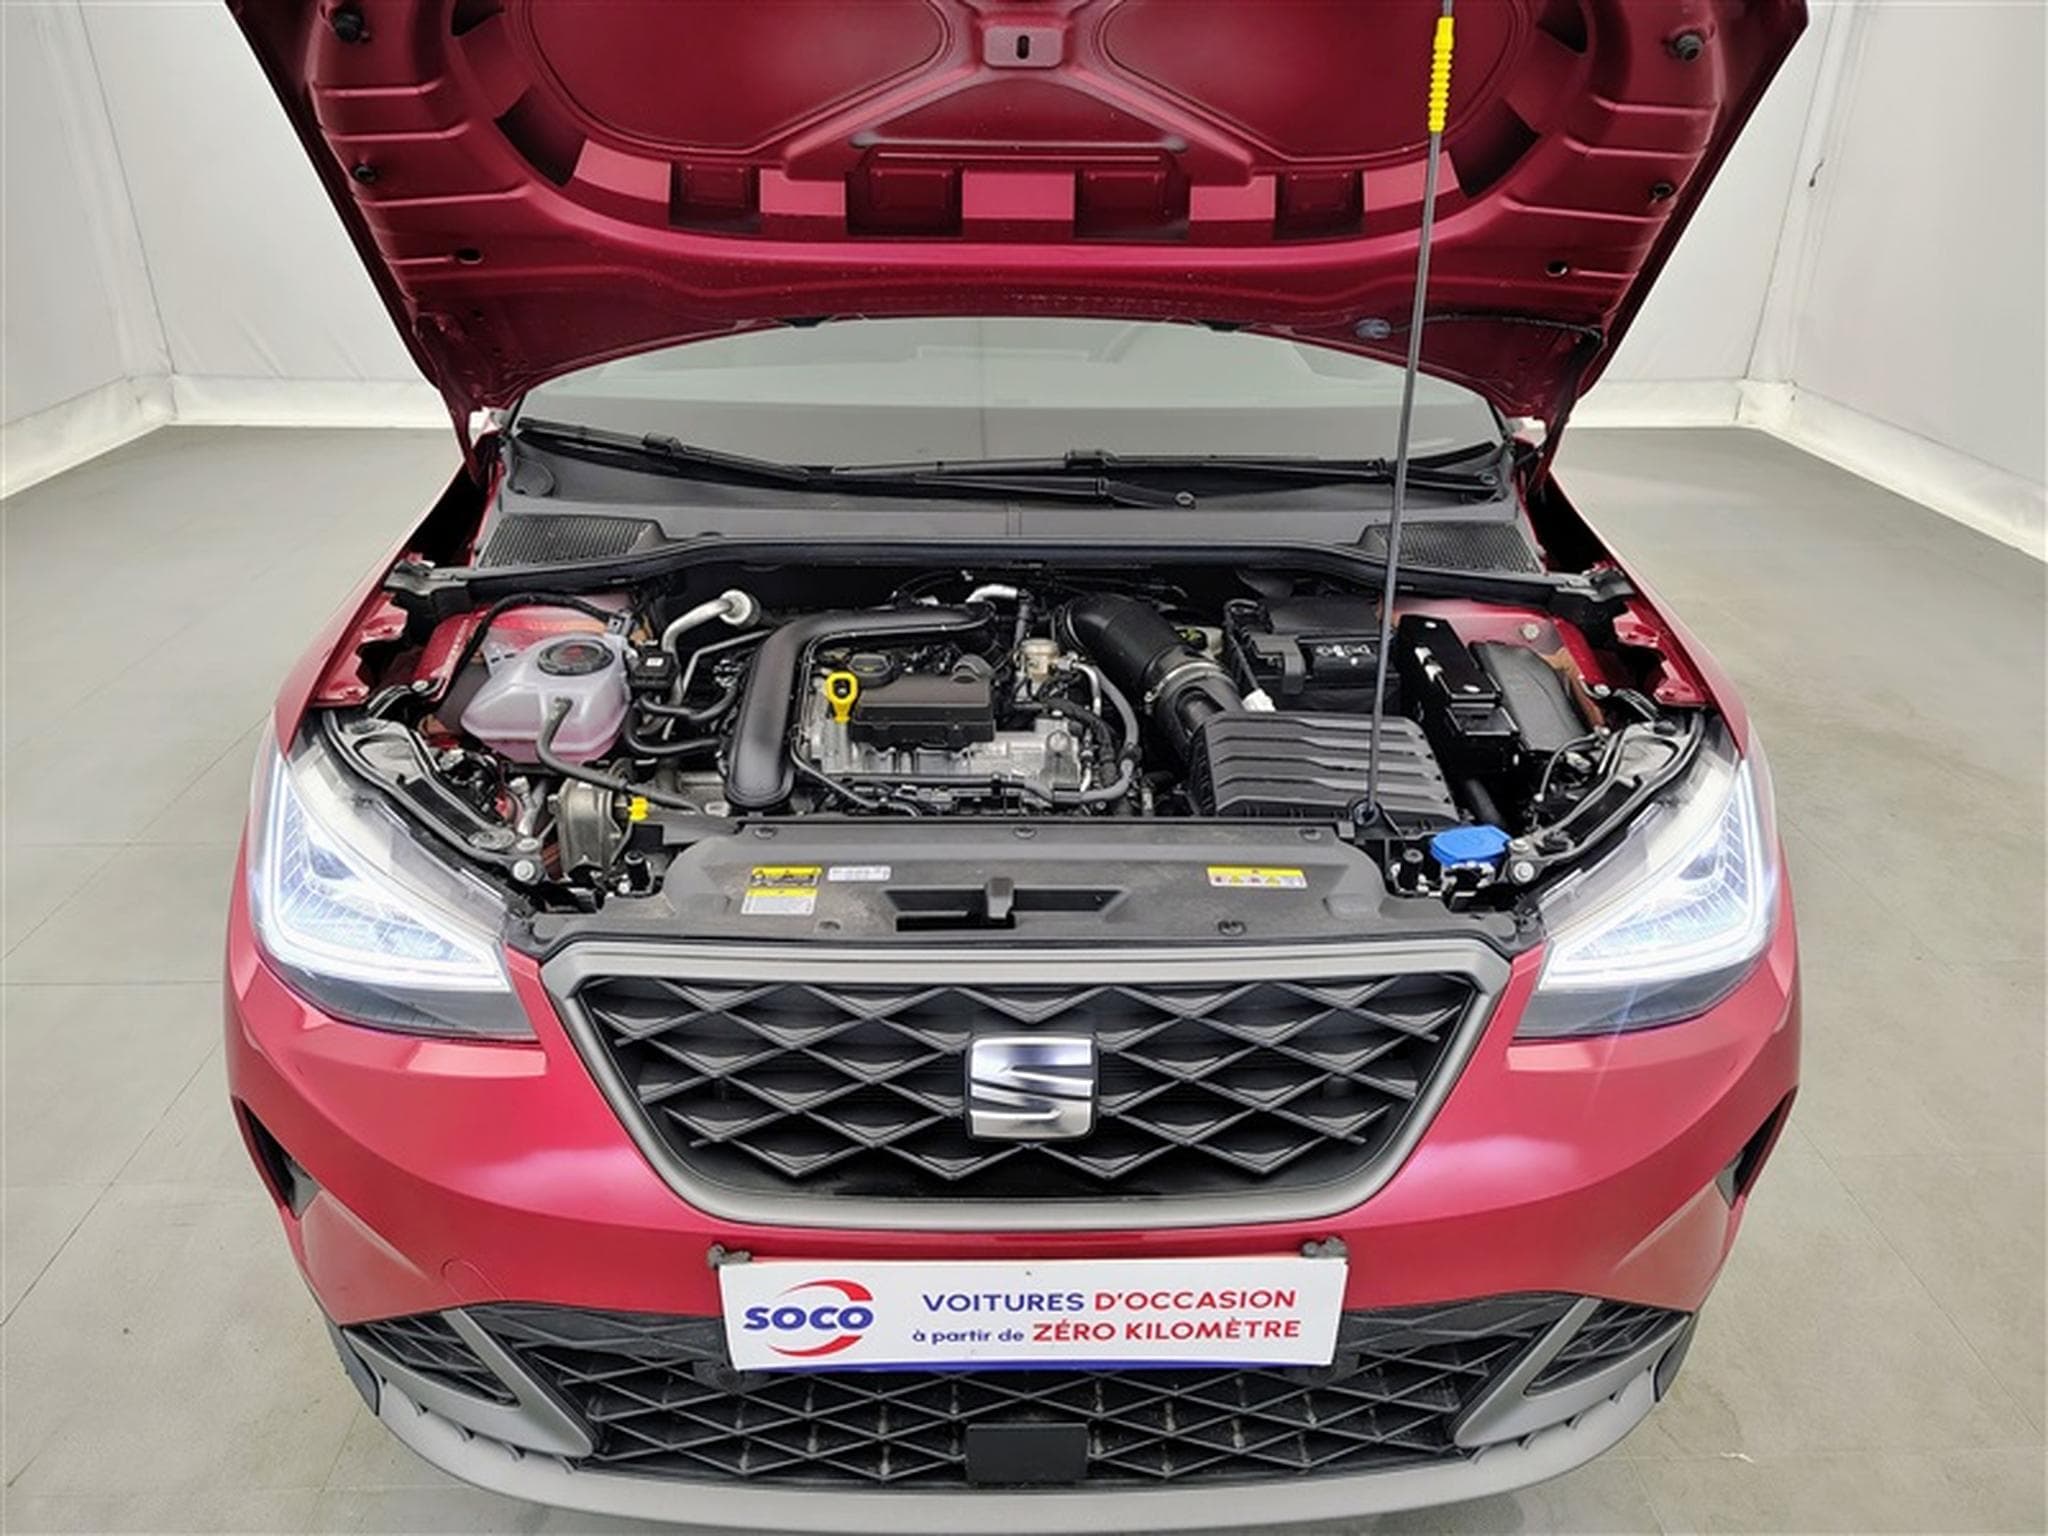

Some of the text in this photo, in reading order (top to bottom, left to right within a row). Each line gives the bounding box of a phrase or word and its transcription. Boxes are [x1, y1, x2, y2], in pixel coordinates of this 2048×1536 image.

[922, 1290, 1296, 1312] VOITURES D'OCCASION
[743, 1306, 874, 1331] SOCO
[912, 1317, 1301, 1345] à partir de ZÉRO KILOMÈTRE
